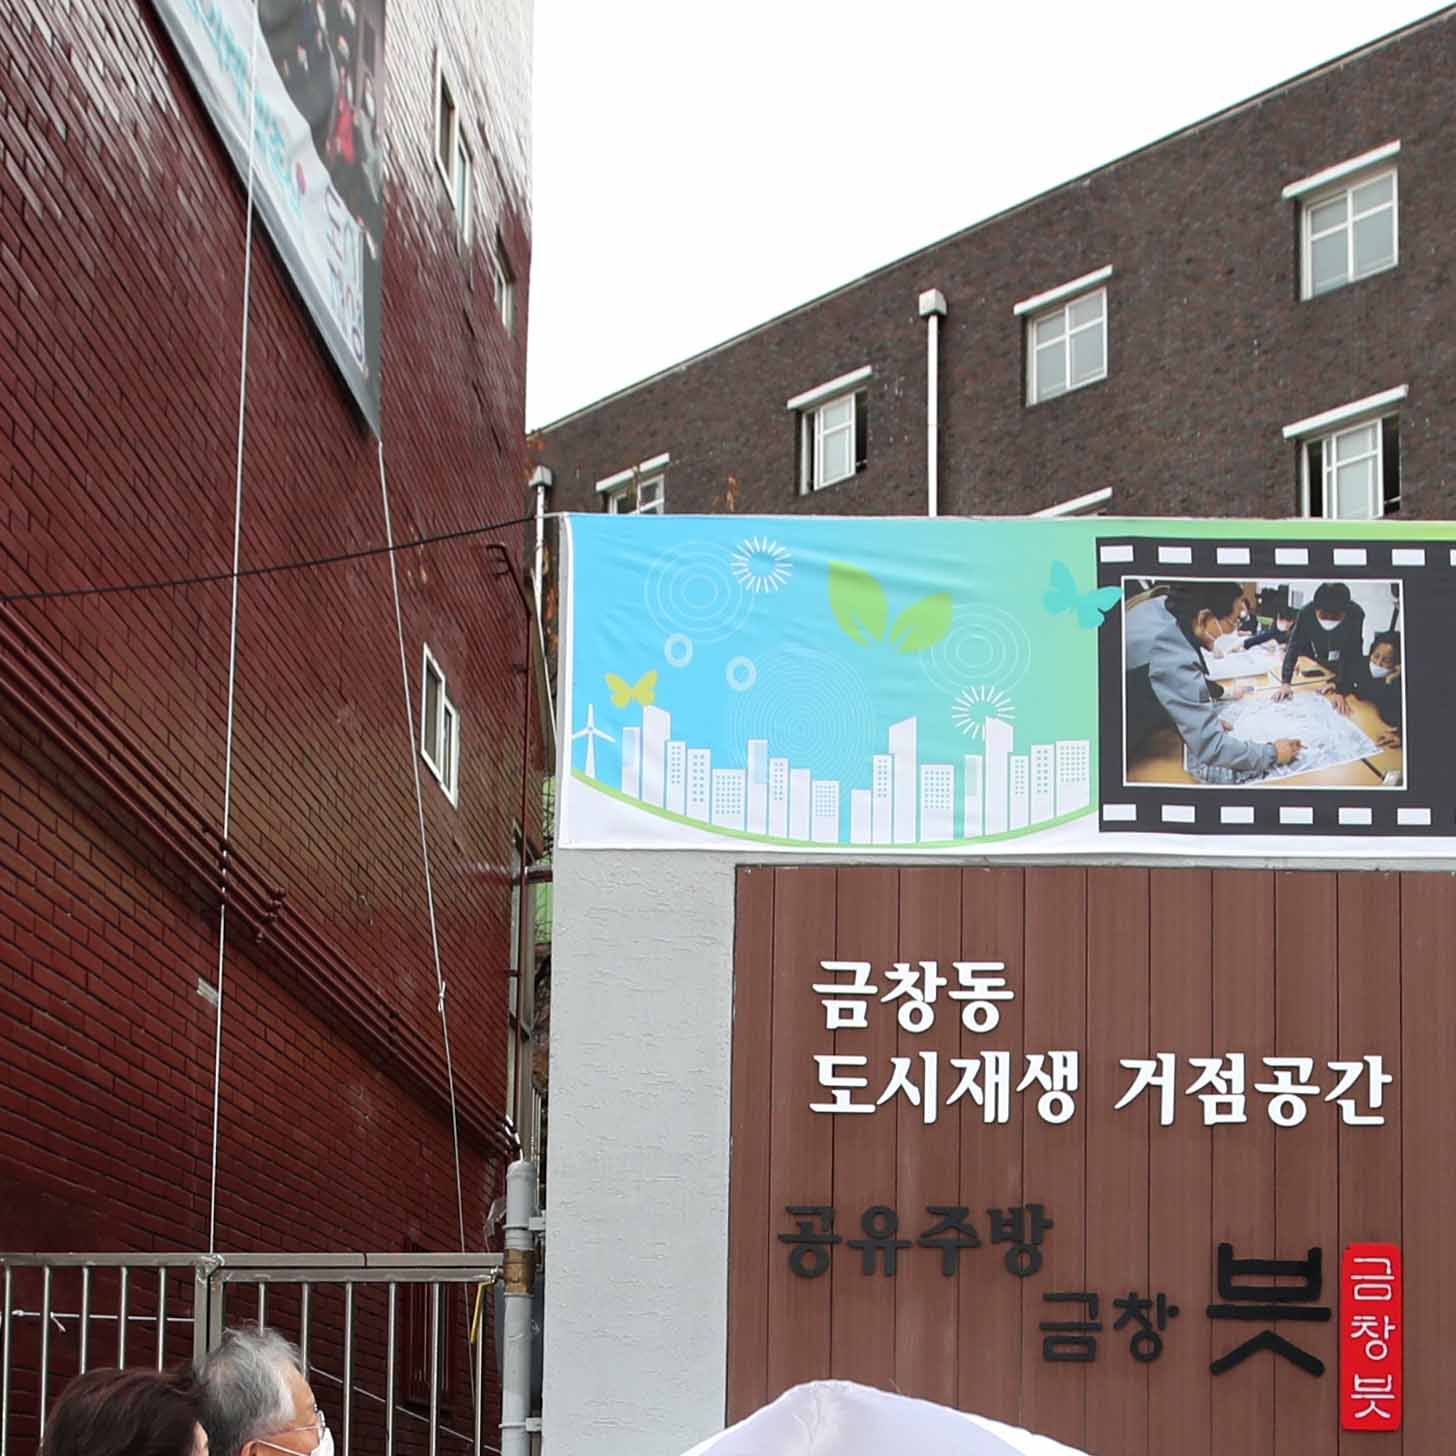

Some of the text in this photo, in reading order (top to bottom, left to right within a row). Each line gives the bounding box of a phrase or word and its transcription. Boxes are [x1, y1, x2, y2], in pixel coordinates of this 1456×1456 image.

[811, 960, 1015, 1034] 금창동
[809, 1050, 1394, 1127] 도시재생 거점공간
[777, 1203, 1054, 1278] 공유주방
[1039, 1291, 1179, 1363] 금창
